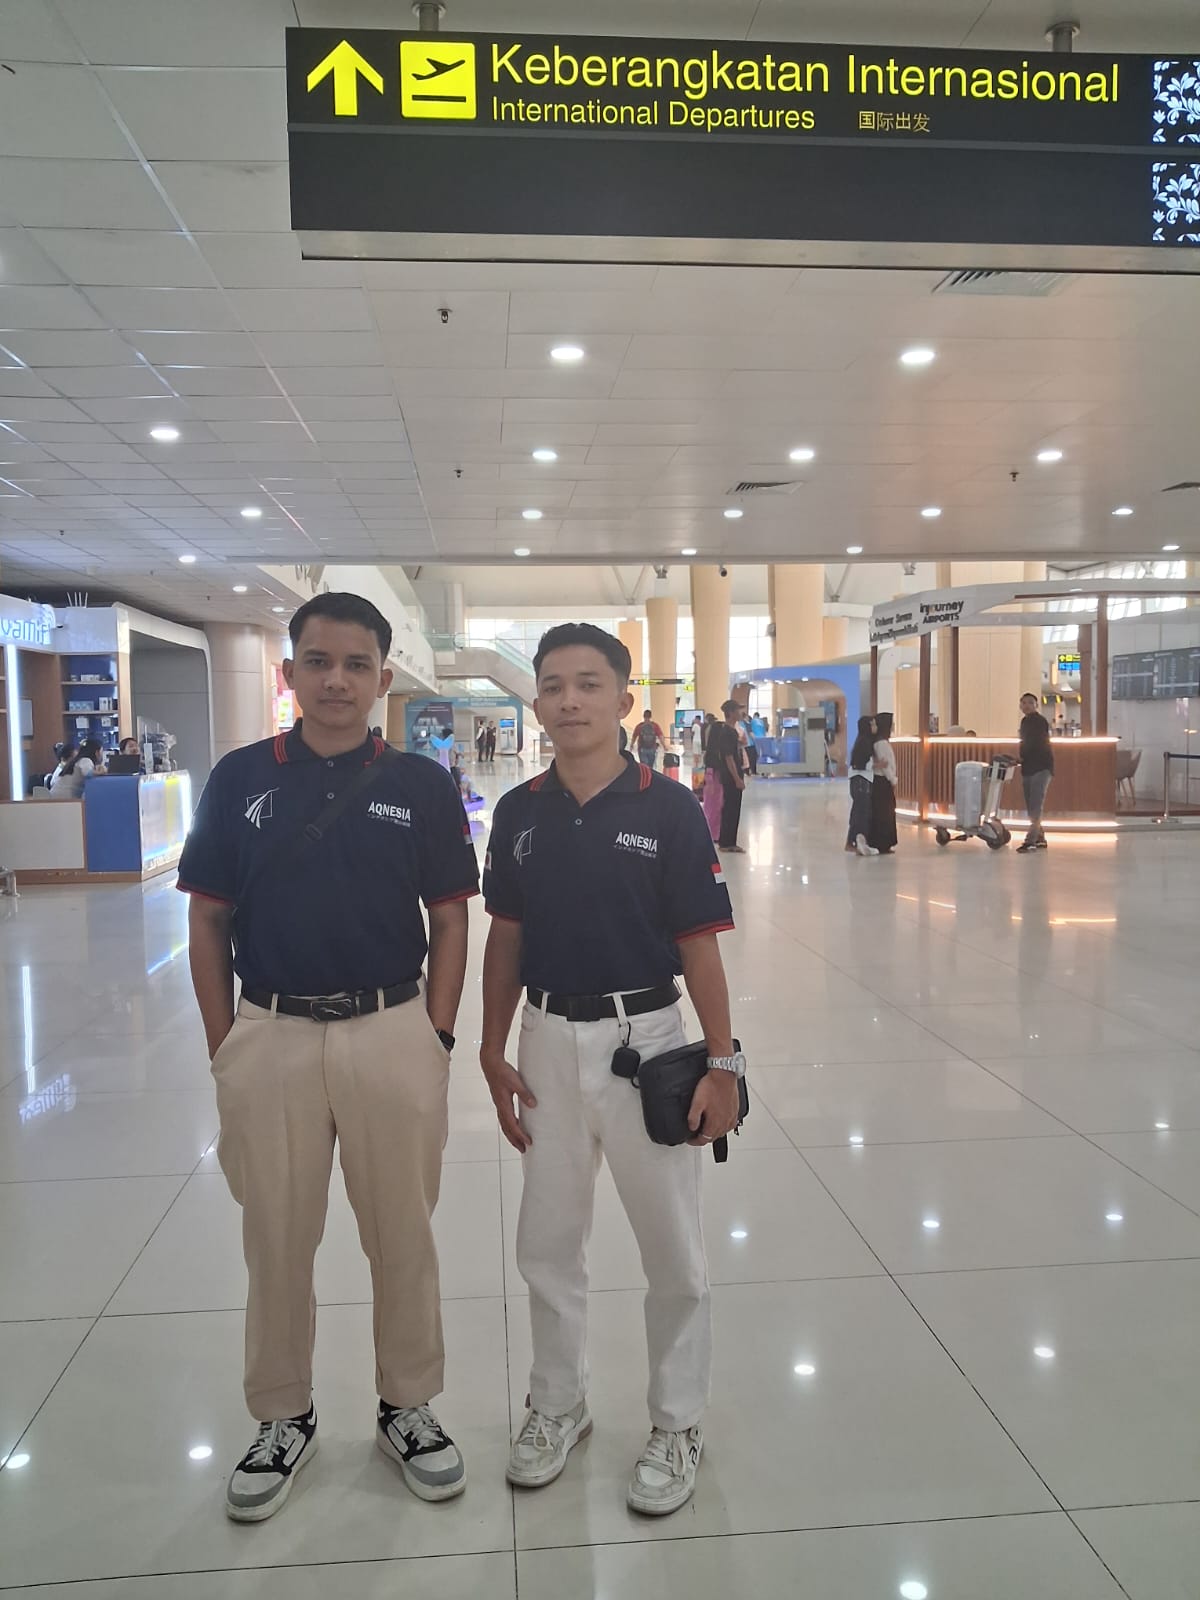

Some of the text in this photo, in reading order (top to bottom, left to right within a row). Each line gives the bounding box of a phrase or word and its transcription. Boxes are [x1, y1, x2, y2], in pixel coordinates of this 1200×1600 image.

[491, 43, 1119, 103] Keberangkatan Internasional
[492, 96, 815, 132] International Departures
[859, 110, 931, 132] 国际出发
[368, 801, 411, 822] AQNESIA
[615, 831, 658, 853] AQNESIA
